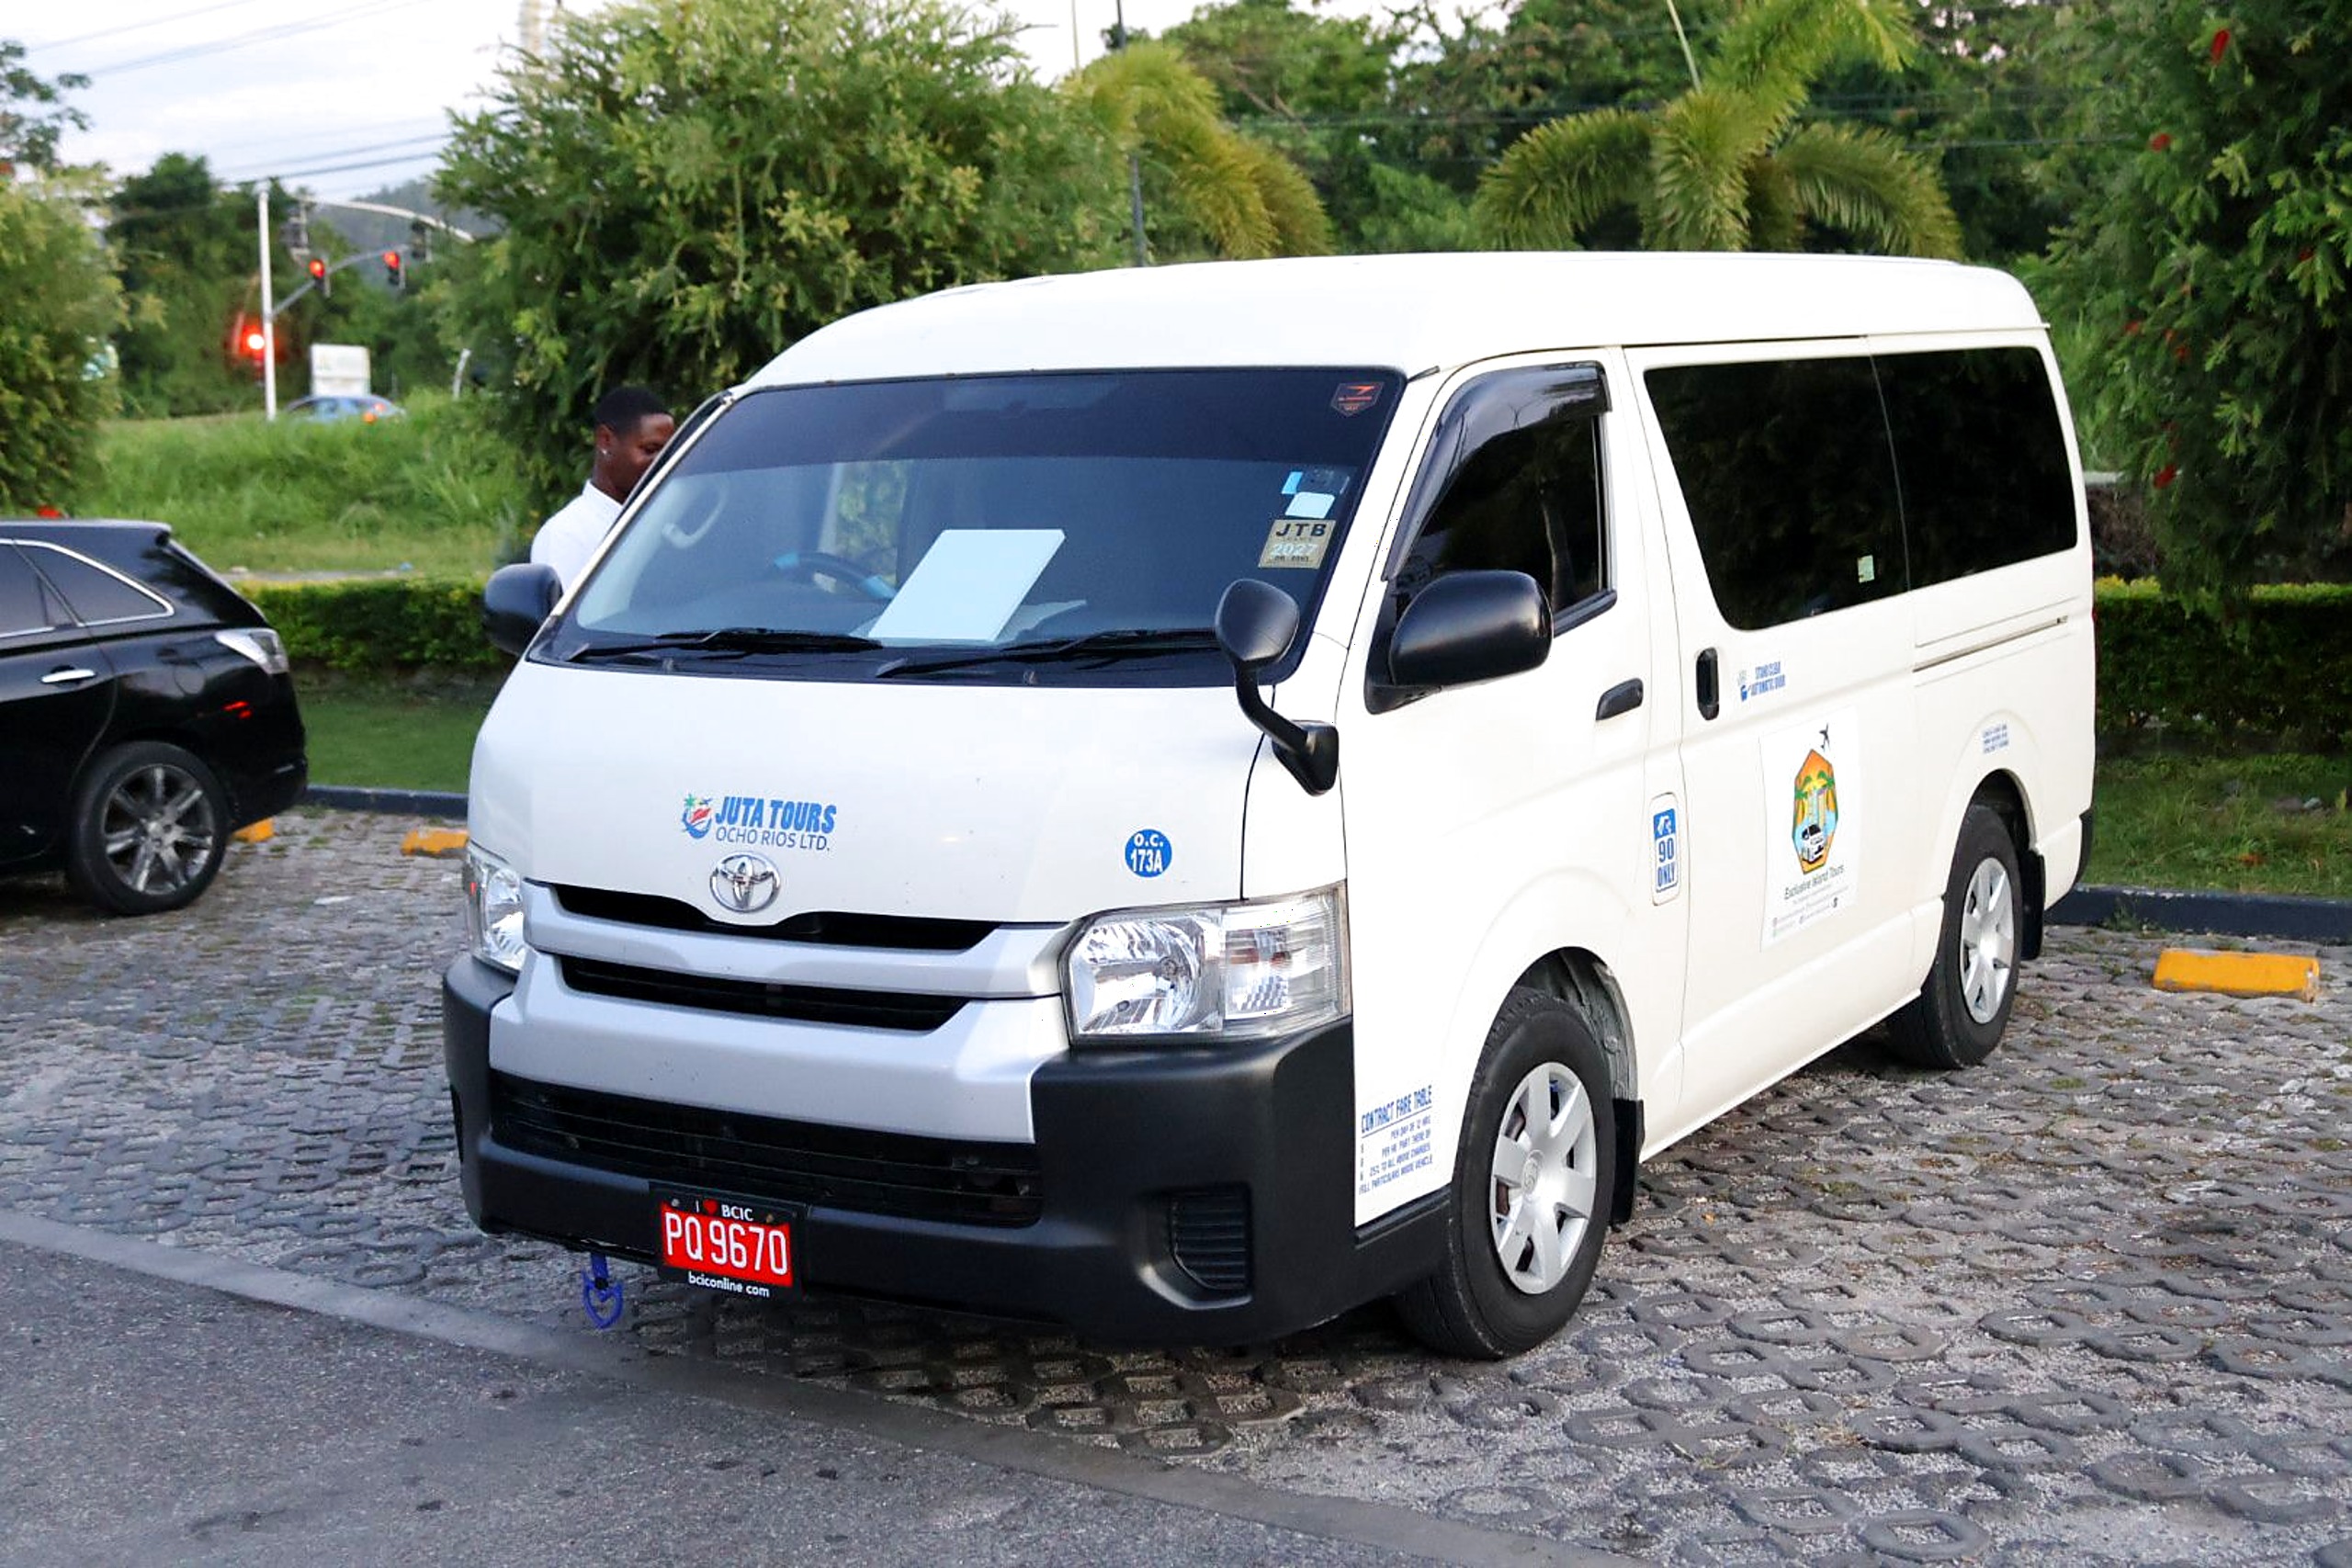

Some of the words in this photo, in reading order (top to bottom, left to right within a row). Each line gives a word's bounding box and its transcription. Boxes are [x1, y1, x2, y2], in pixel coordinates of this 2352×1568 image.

[1276, 523, 1327, 536] JTB
[716, 796, 765, 829] JUTA
[769, 799, 837, 834] TOURS
[716, 827, 758, 845] OCHO
[761, 831, 796, 848] RIOS
[800, 835, 830, 851] LTD.
[1134, 833, 1164, 847] O.C.
[1659, 837, 1674, 863] 90
[1131, 848, 1163, 872] 173A
[1361, 1101, 1394, 1134] CONTRACT
[1396, 1093, 1412, 1119] FARE
[1414, 1084, 1432, 1110] TABLE
[721, 1204, 754, 1222] BCIC
[665, 1212, 703, 1262] PQ
[709, 1220, 788, 1275] 9670
